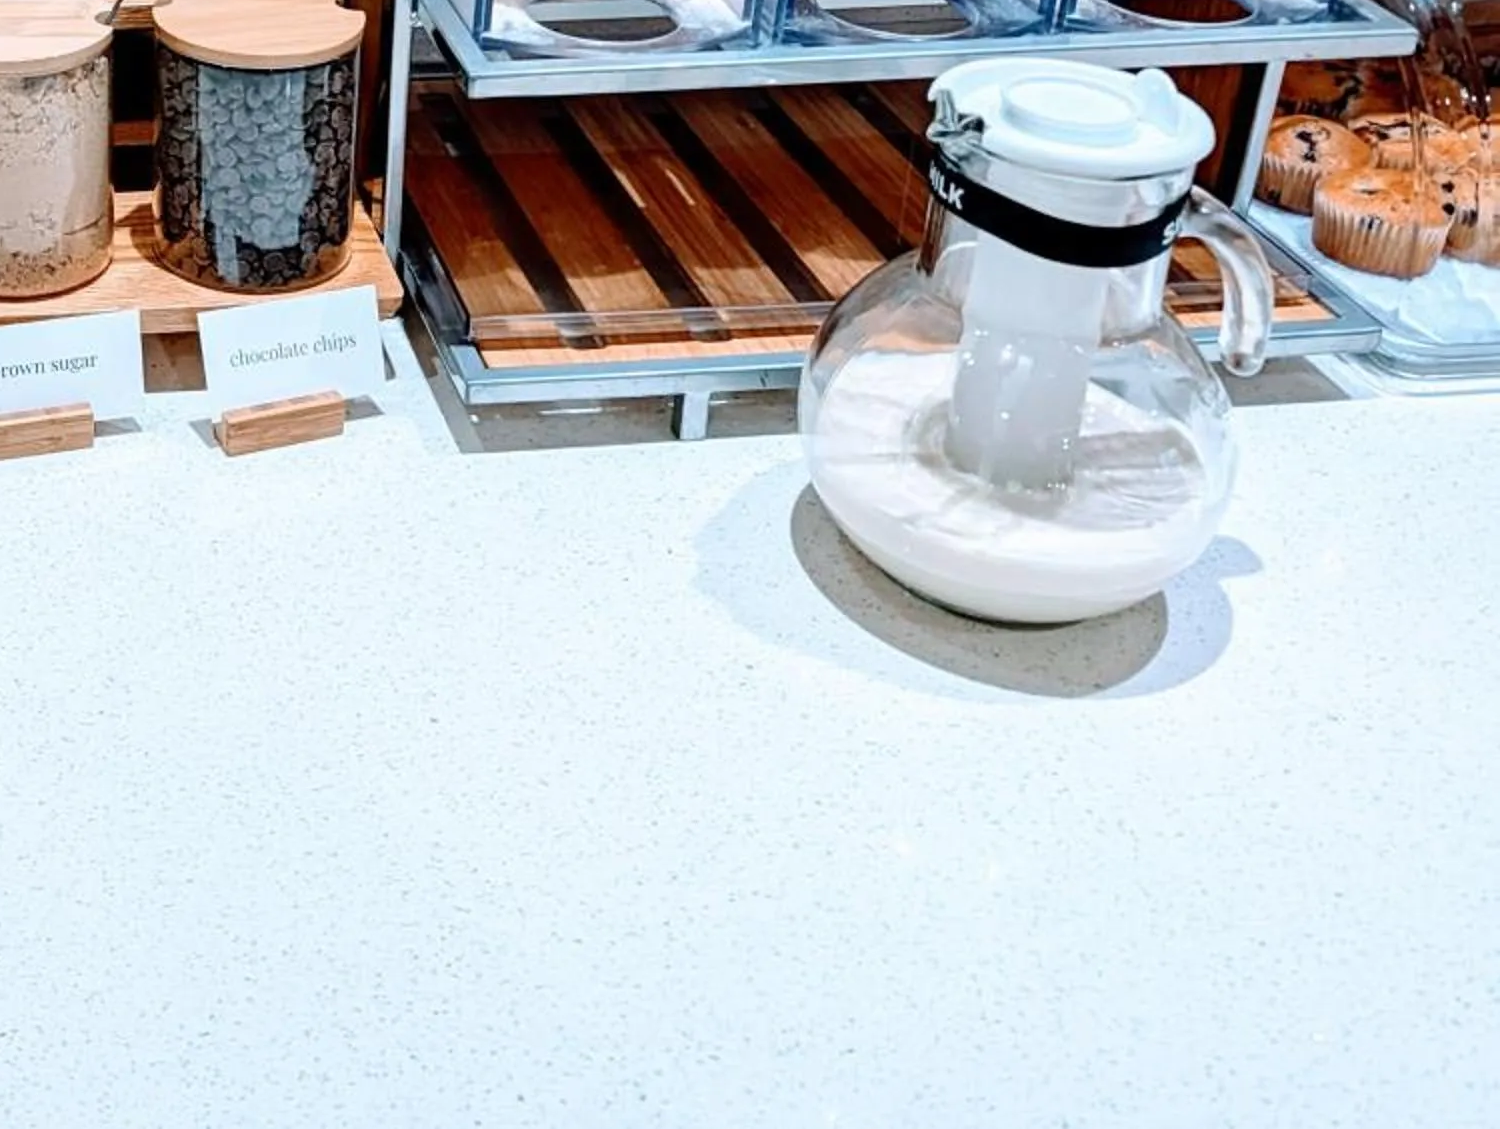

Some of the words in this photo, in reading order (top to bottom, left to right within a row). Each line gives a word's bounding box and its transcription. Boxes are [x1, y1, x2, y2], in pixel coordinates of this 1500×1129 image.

[229, 342, 309, 368] chocolate
[313, 332, 357, 358] chips
[51, 355, 99, 376] sugar
